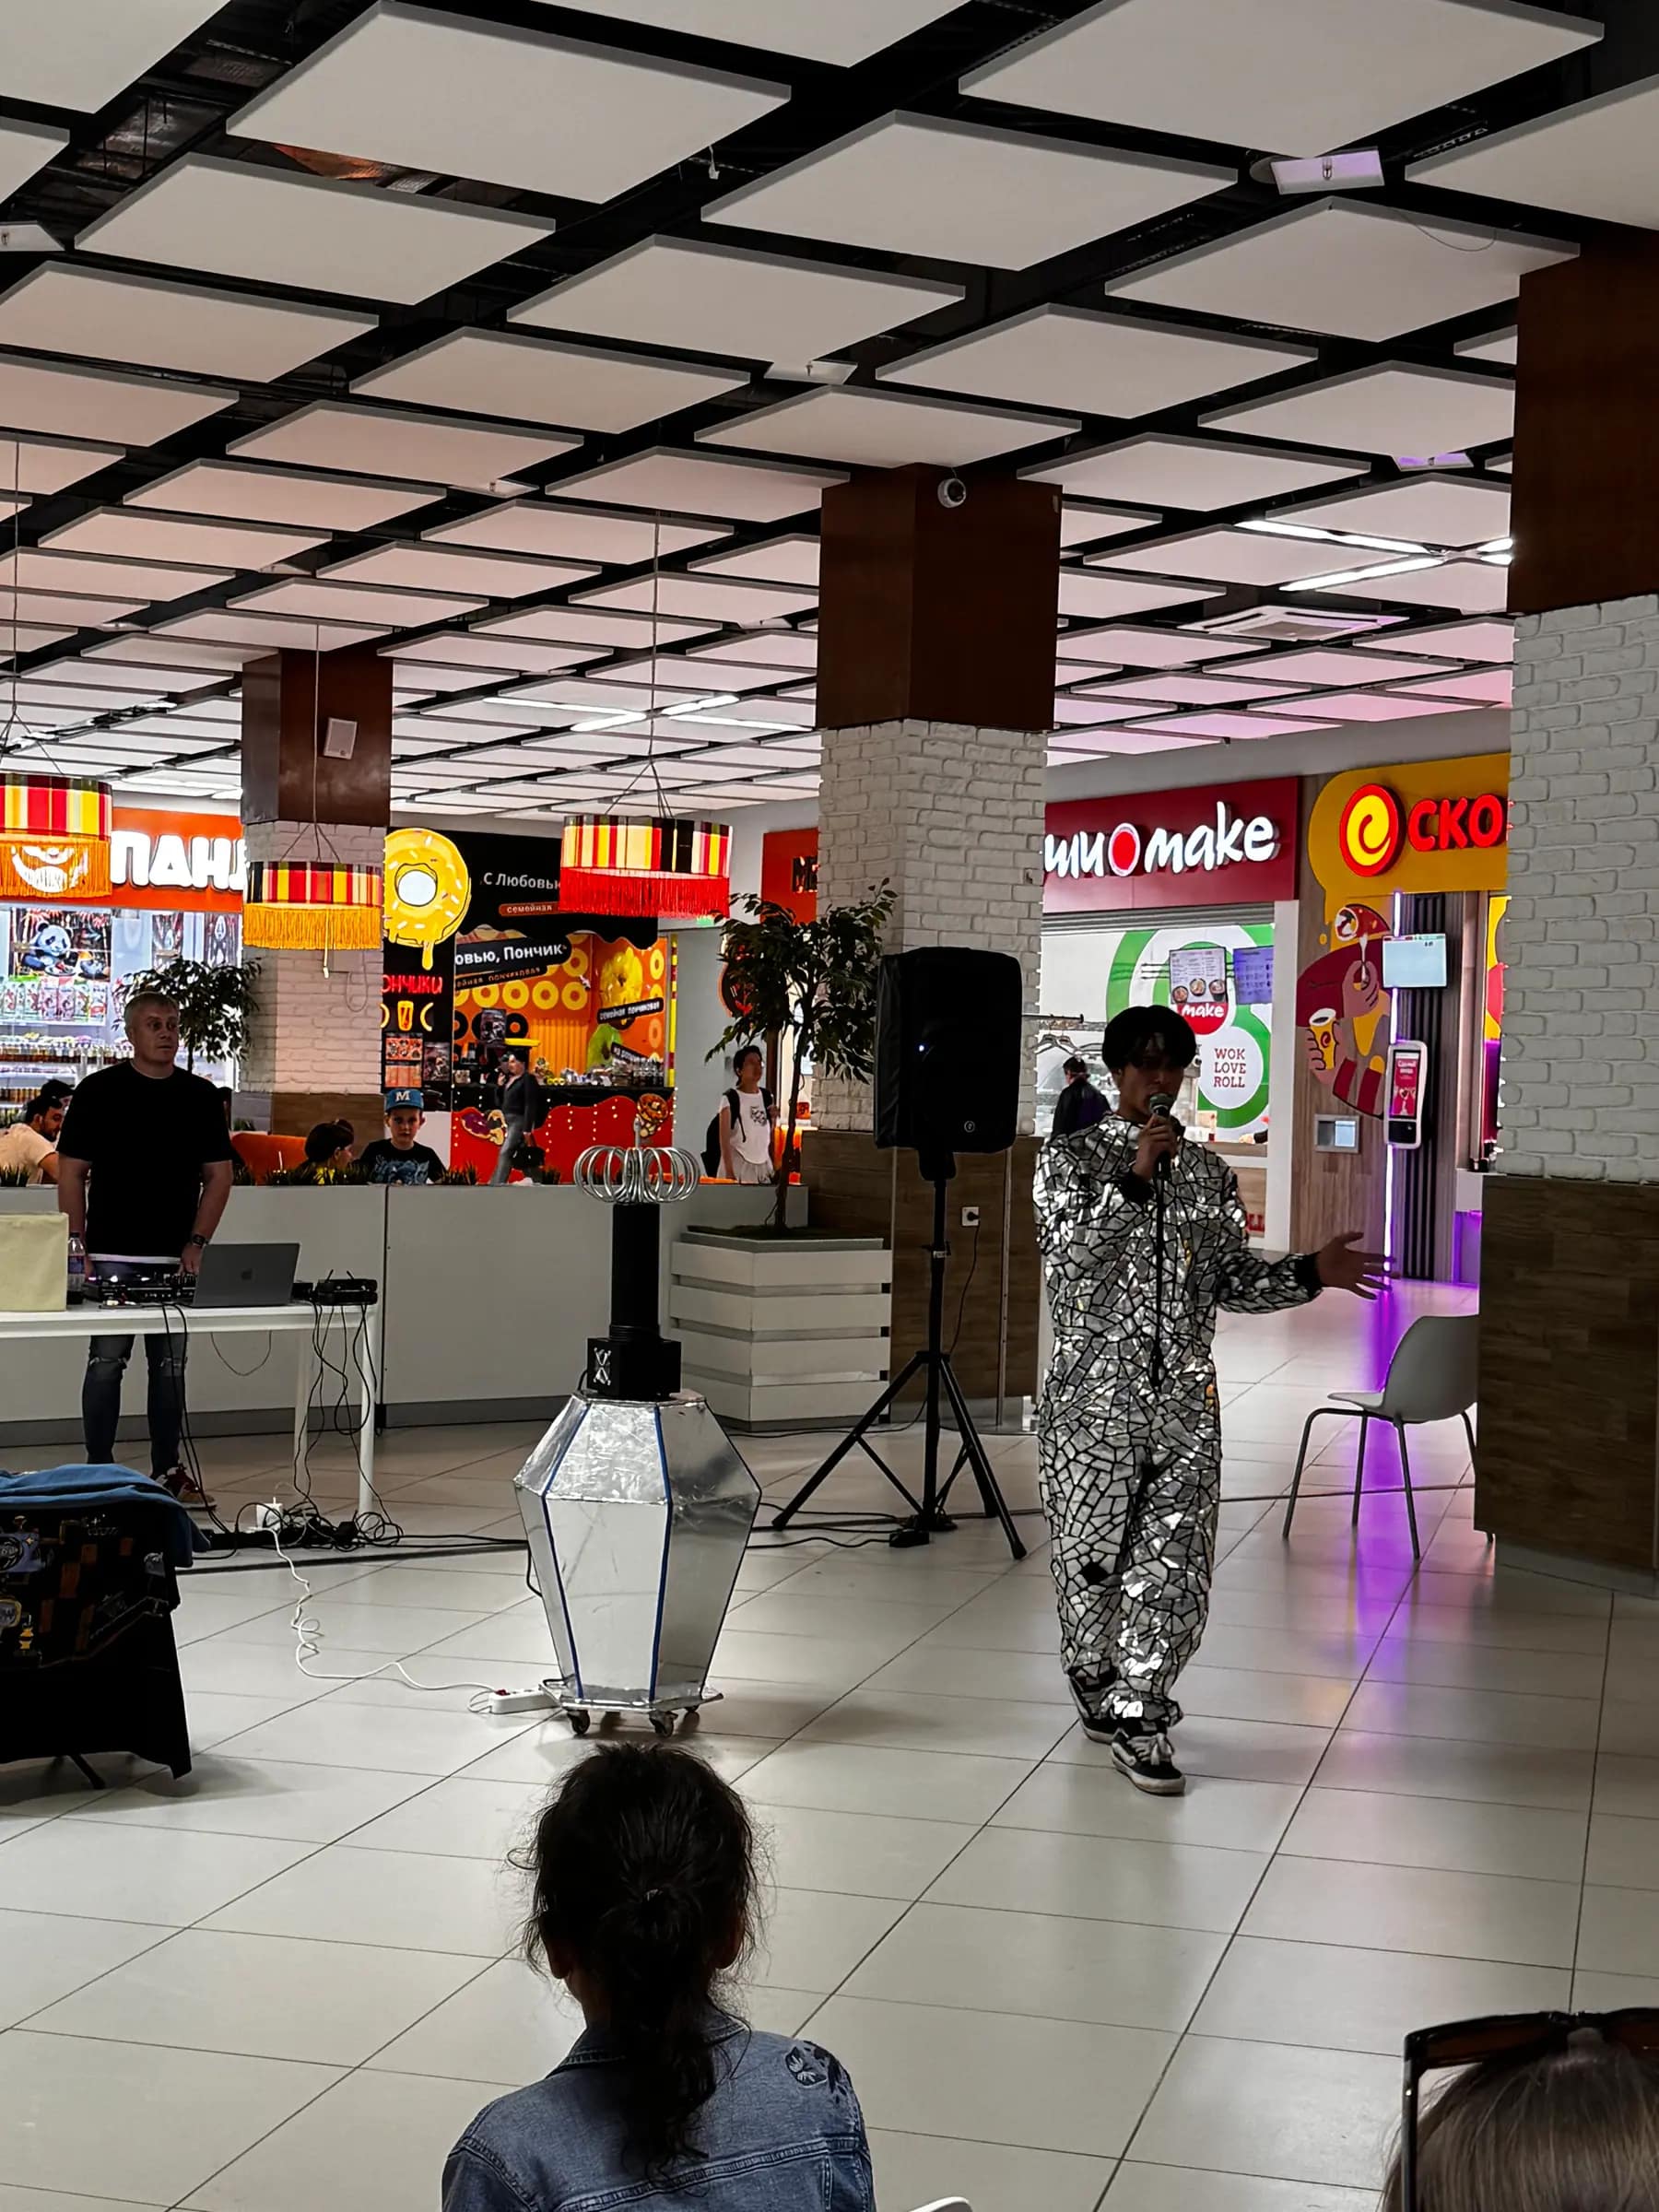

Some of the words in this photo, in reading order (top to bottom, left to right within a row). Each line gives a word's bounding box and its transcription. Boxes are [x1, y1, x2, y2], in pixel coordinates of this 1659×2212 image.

[1145, 801, 1276, 874] make
[483, 872, 493, 886] С
[503, 944, 564, 960] Пончик
[1181, 1002, 1224, 1018] make
[1214, 1047, 1246, 1061] WOK
[1213, 1062, 1247, 1075] LOVE
[1213, 1076, 1246, 1088] ROLL
[394, 1090, 411, 1102] M
